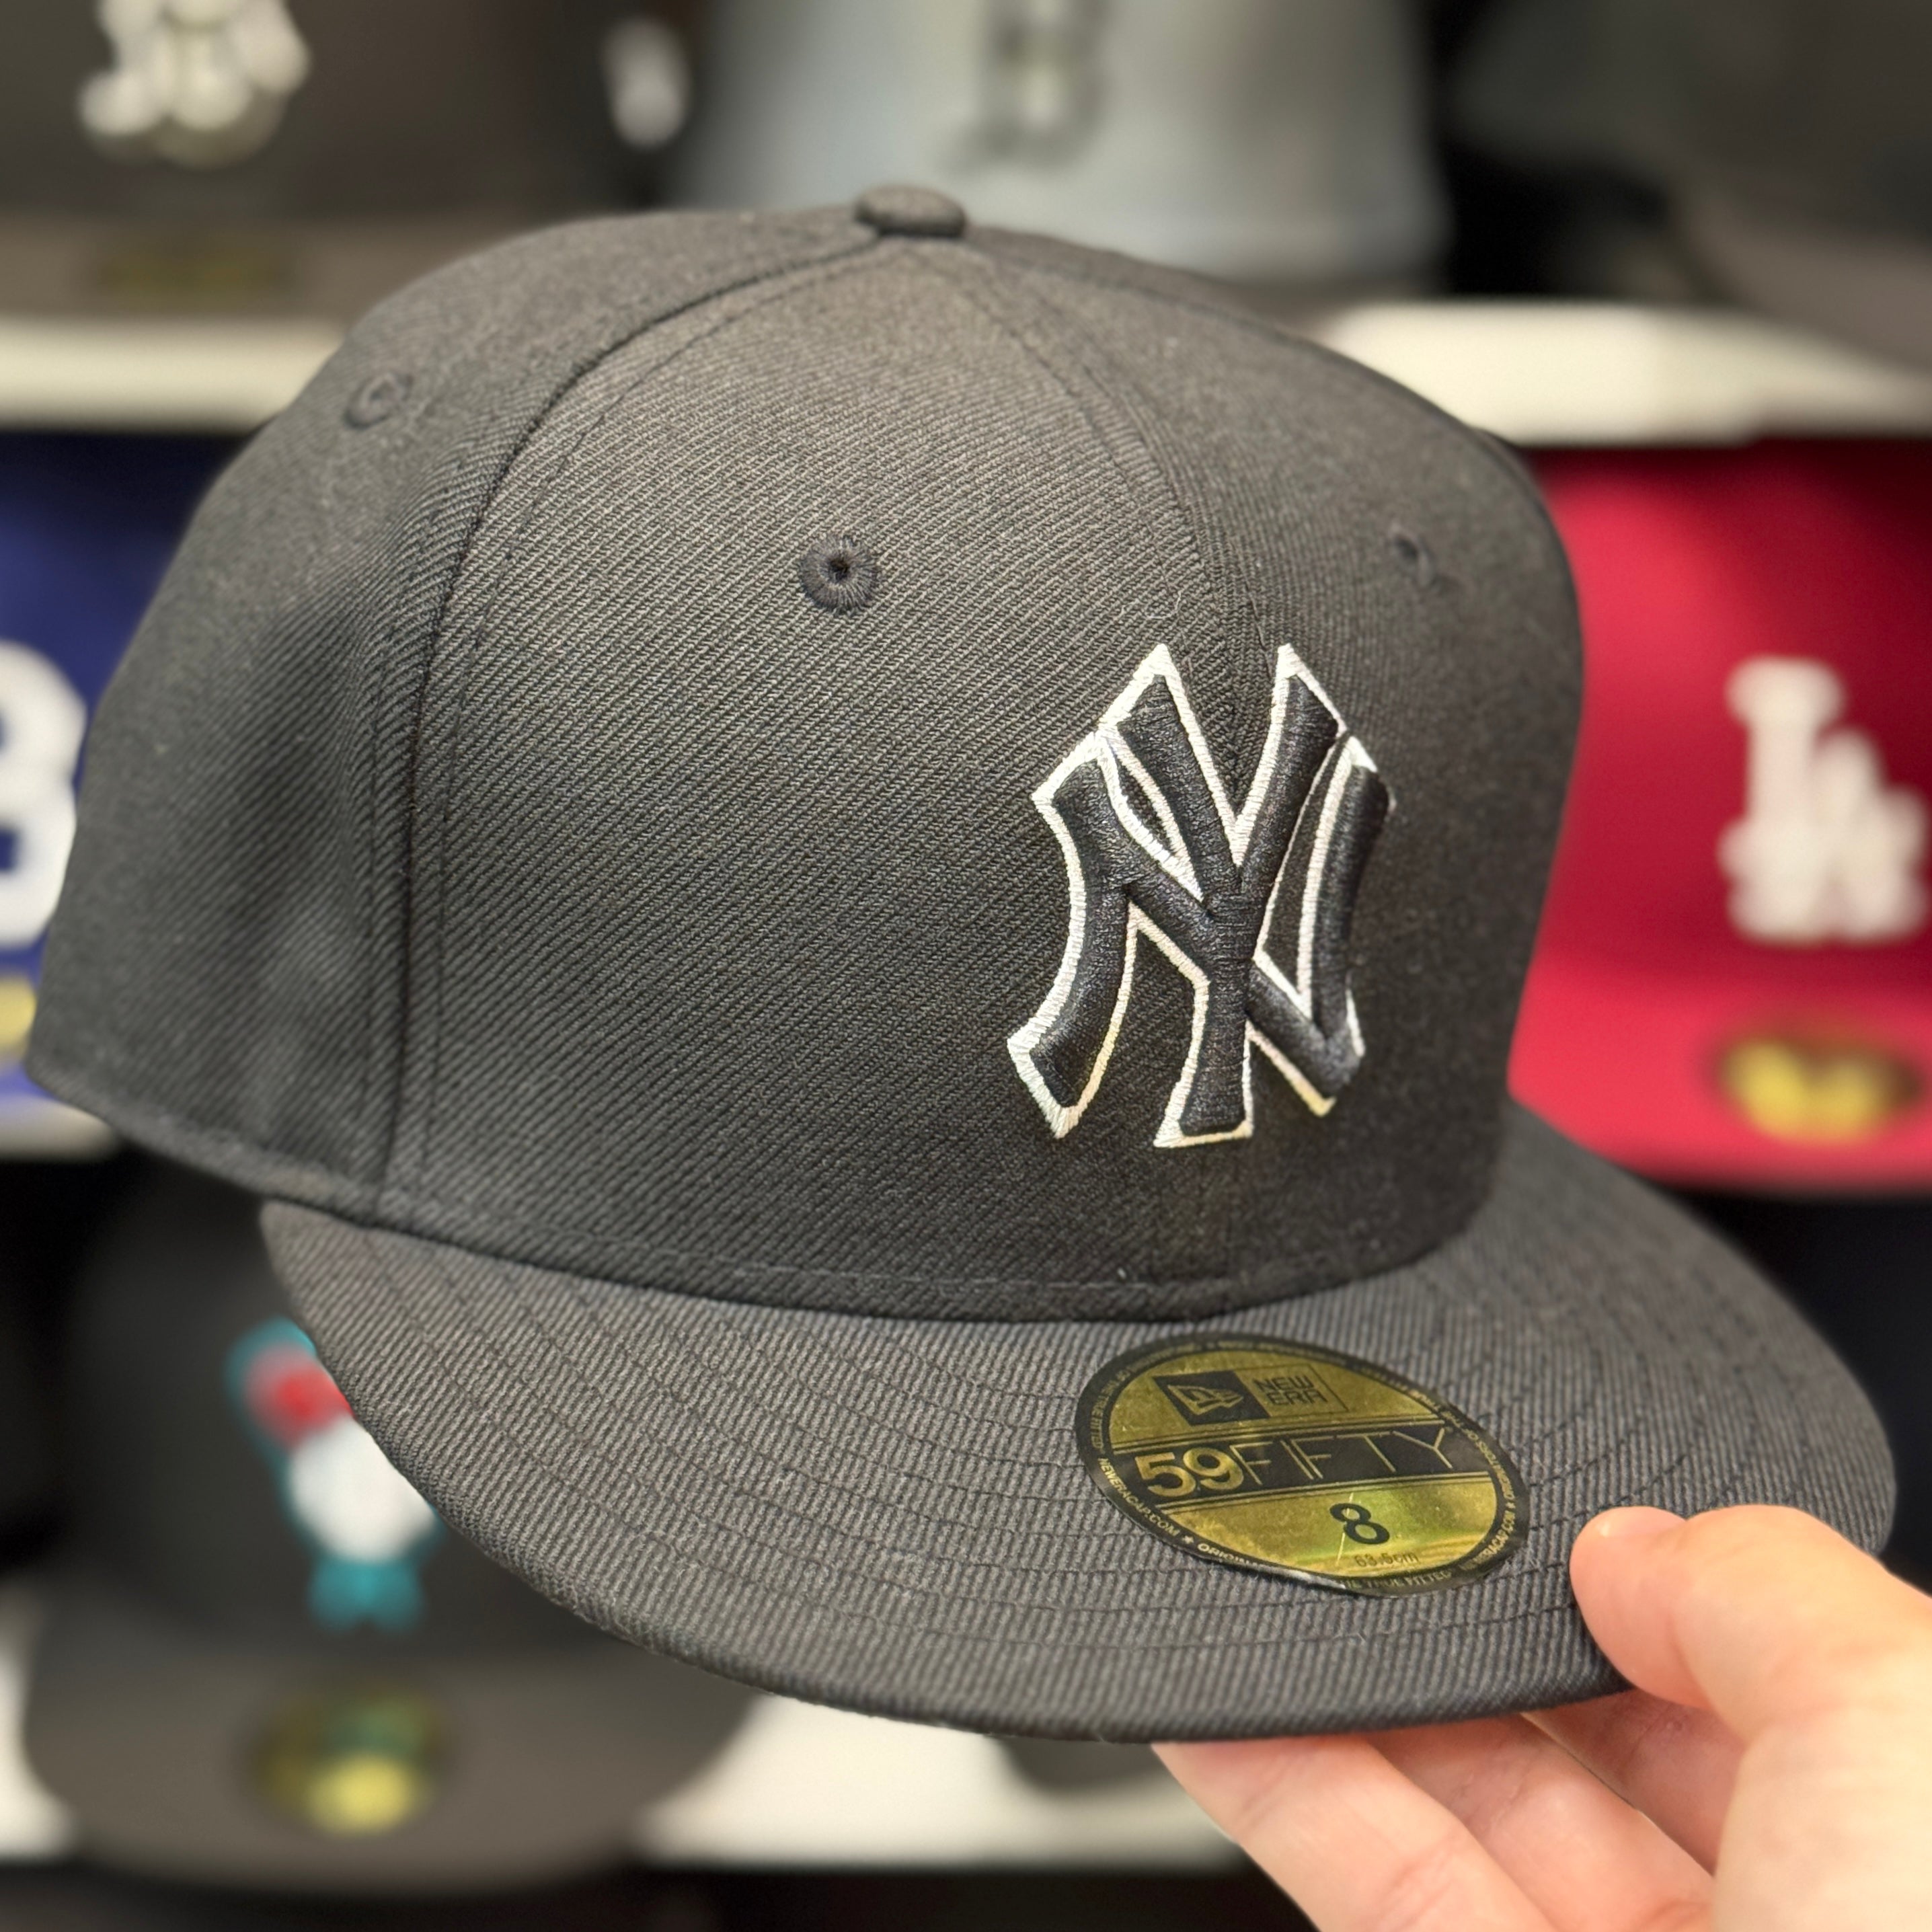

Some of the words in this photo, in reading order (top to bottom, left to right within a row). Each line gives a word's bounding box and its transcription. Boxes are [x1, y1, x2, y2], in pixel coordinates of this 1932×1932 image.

[1007, 643, 1396, 1148] NY
[1253, 1375, 1315, 1392] NEW
[1266, 1388, 1329, 1406] ERA
[1134, 1427, 1453, 1497] 59FIFTY
[1097, 1457, 1181, 1537] NEWERACAP.COM
[1330, 1502, 1391, 1545] 8
